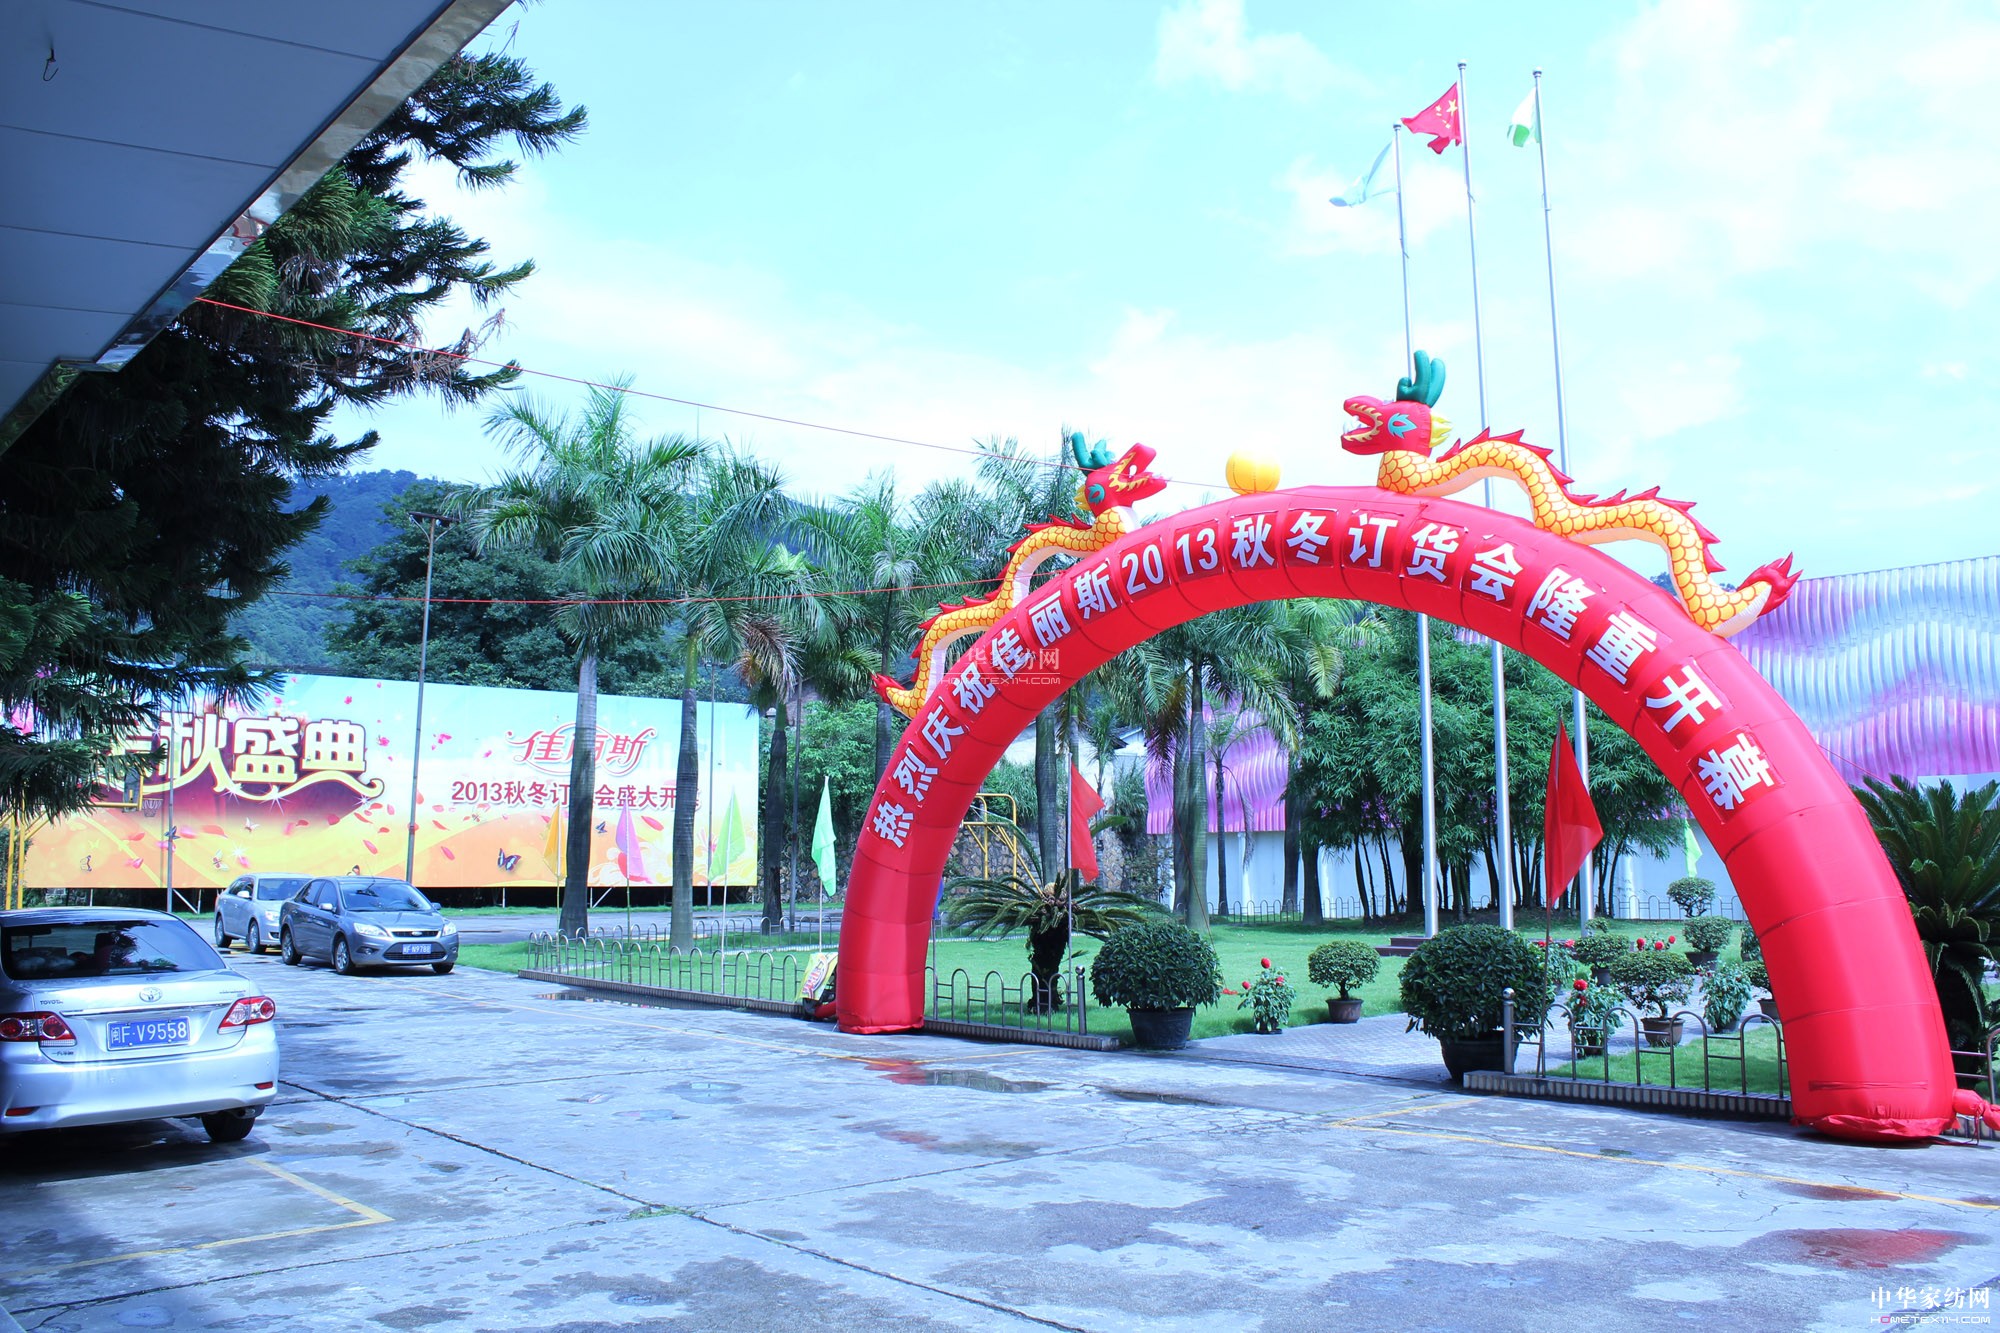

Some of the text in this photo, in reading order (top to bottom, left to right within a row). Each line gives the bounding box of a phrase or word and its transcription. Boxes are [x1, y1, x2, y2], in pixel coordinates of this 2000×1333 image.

[872, 513, 1775, 848] 热烈庆祝佳丽斯2013秋冬订货会隆重开幕
[452, 781, 699, 808] 2013秋冬订会盛大开
